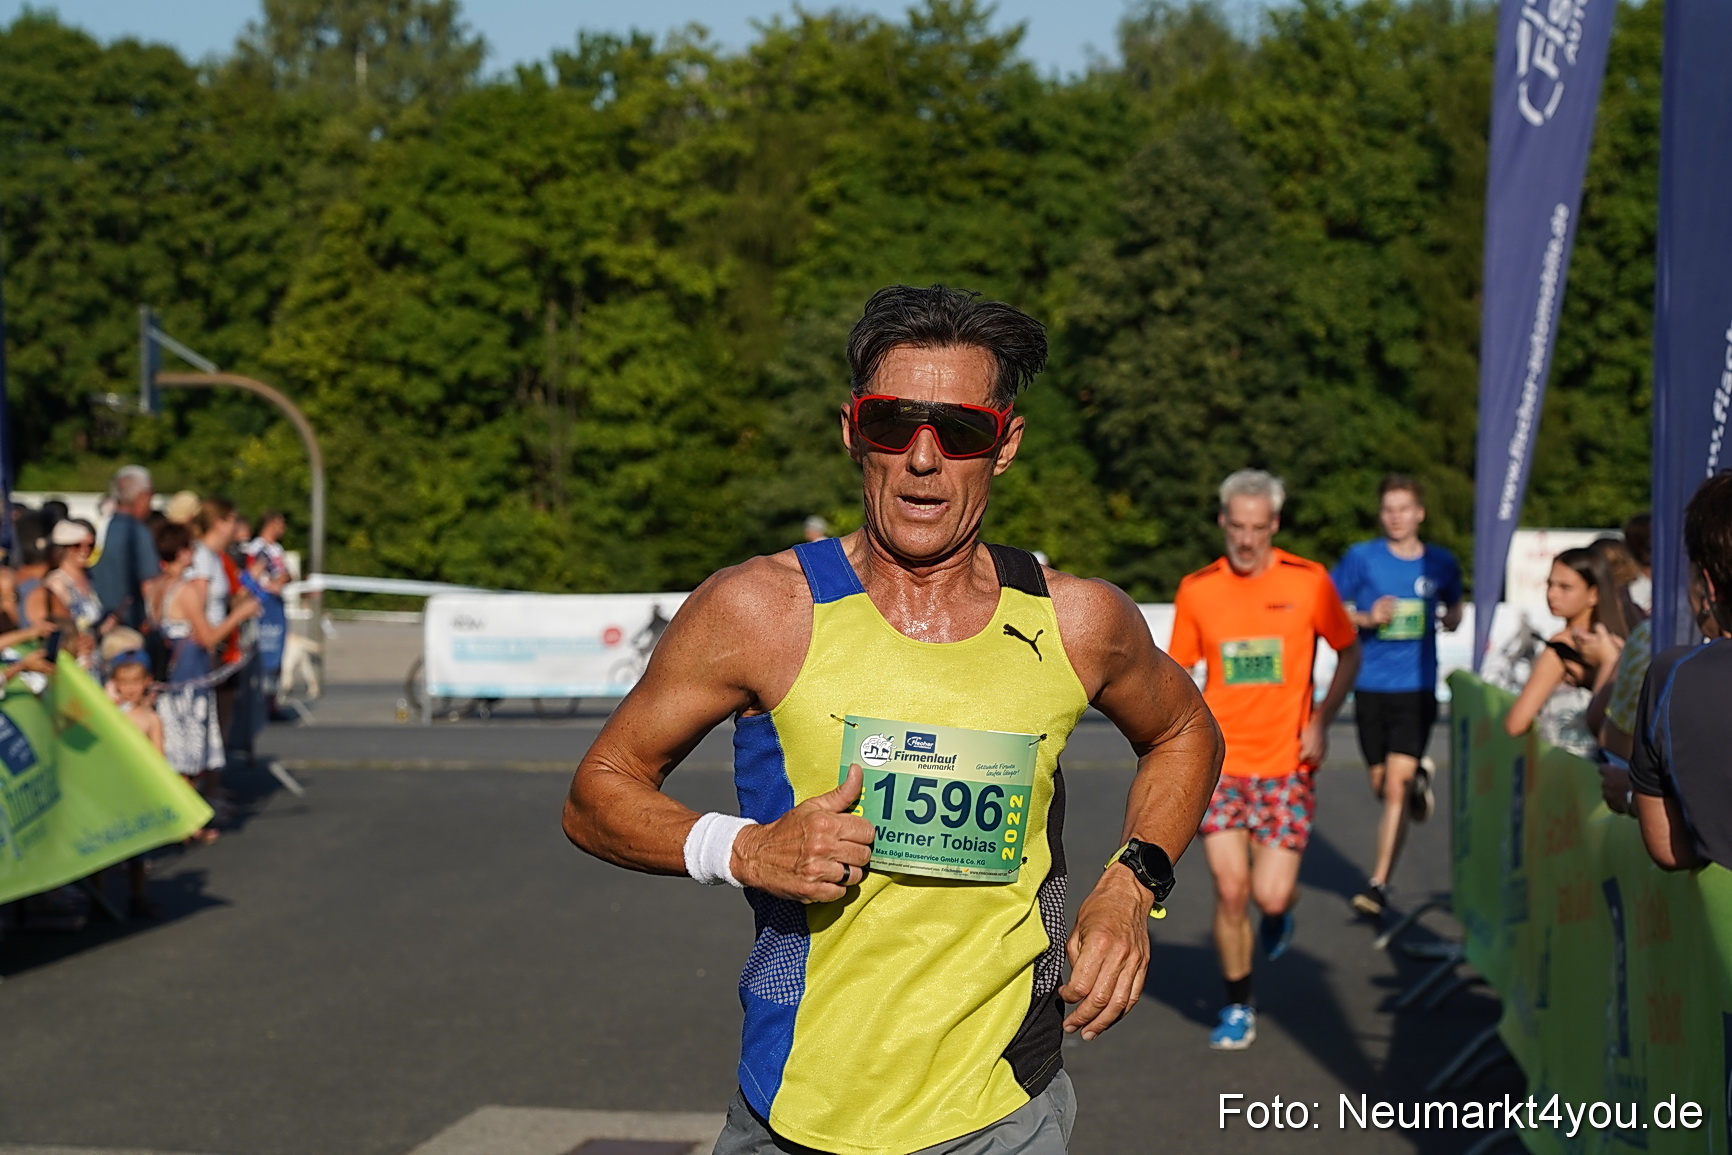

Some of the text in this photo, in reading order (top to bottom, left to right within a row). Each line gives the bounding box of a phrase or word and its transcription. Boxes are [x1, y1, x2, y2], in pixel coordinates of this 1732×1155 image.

[894, 751, 958, 764] Firmenlauf
[917, 763, 955, 772] neumarkt
[873, 772, 1005, 832] 1596
[1001, 794, 1024, 861] 2022
[940, 832, 997, 853] Tobias
[875, 847, 888, 856] Max
[889, 849, 903, 858] Bögl
[904, 852, 940, 862] Bauservice
[940, 855, 960, 864] GmbH
[965, 857, 976, 866] Co.
[976, 858, 986, 866] KG
